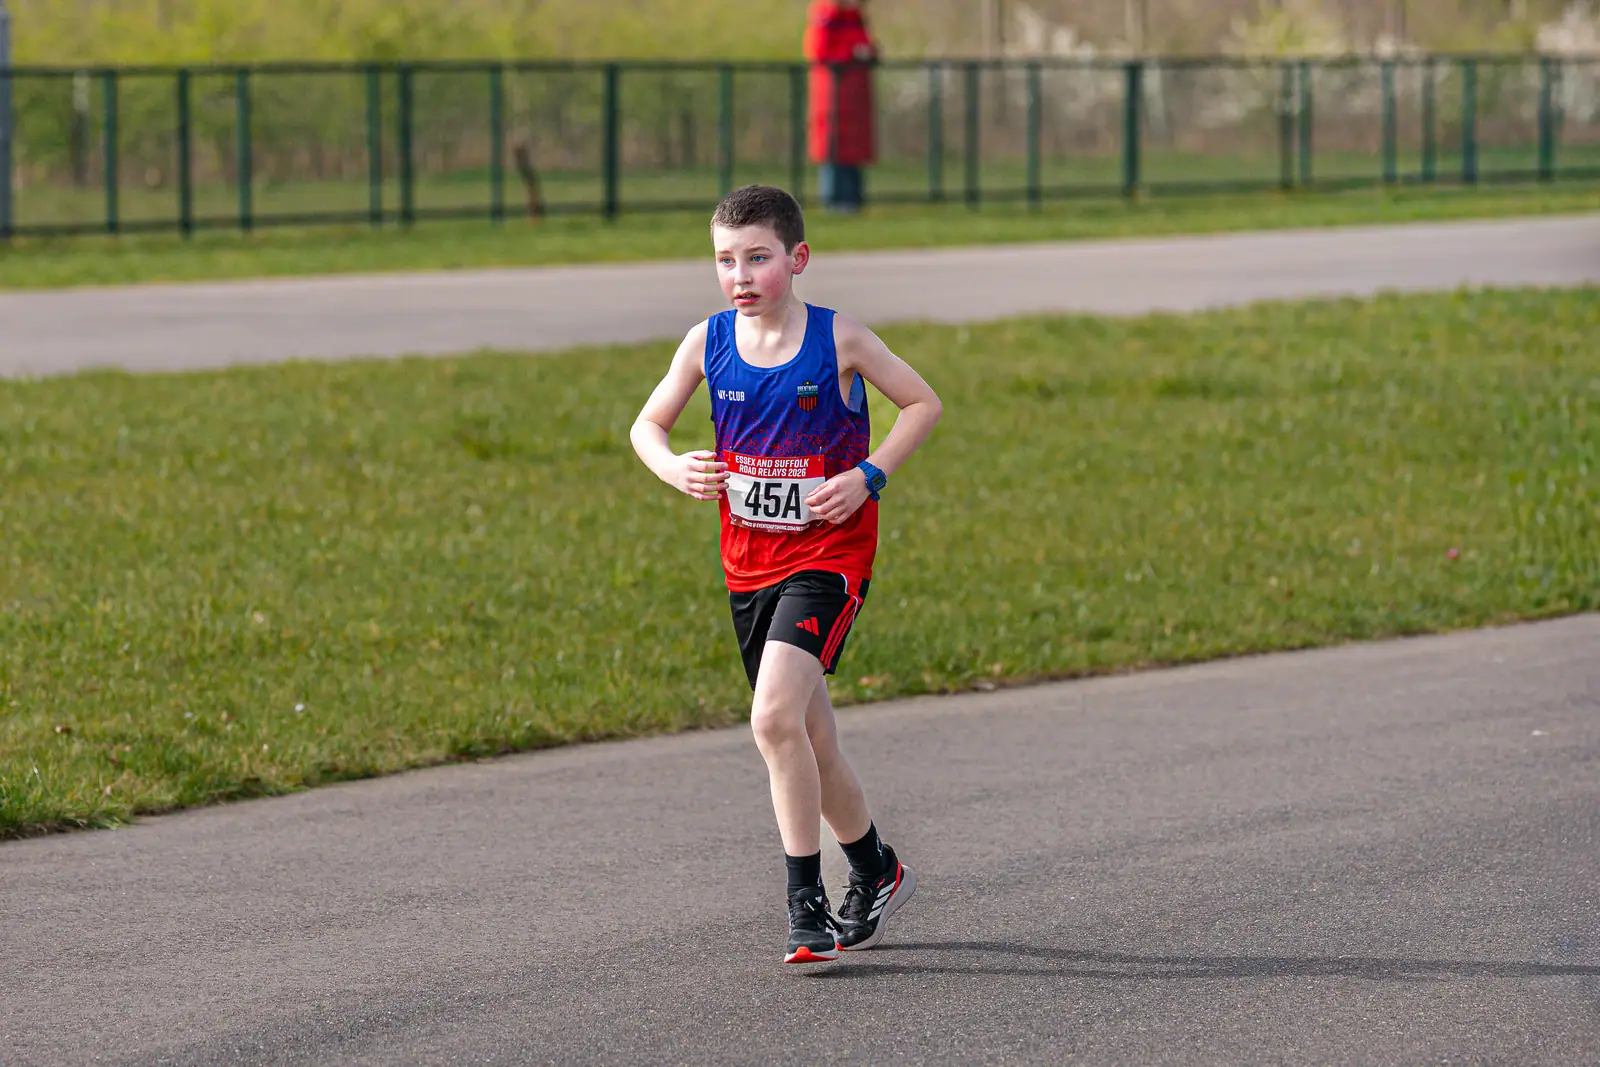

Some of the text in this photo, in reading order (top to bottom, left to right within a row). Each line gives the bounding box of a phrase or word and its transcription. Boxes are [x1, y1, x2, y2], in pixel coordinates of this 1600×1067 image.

[735, 455, 809, 468] ESSEX AND SUFFOLK
[739, 464, 806, 477] ROAD RELAYS 2026
[744, 481, 801, 520] 45A
